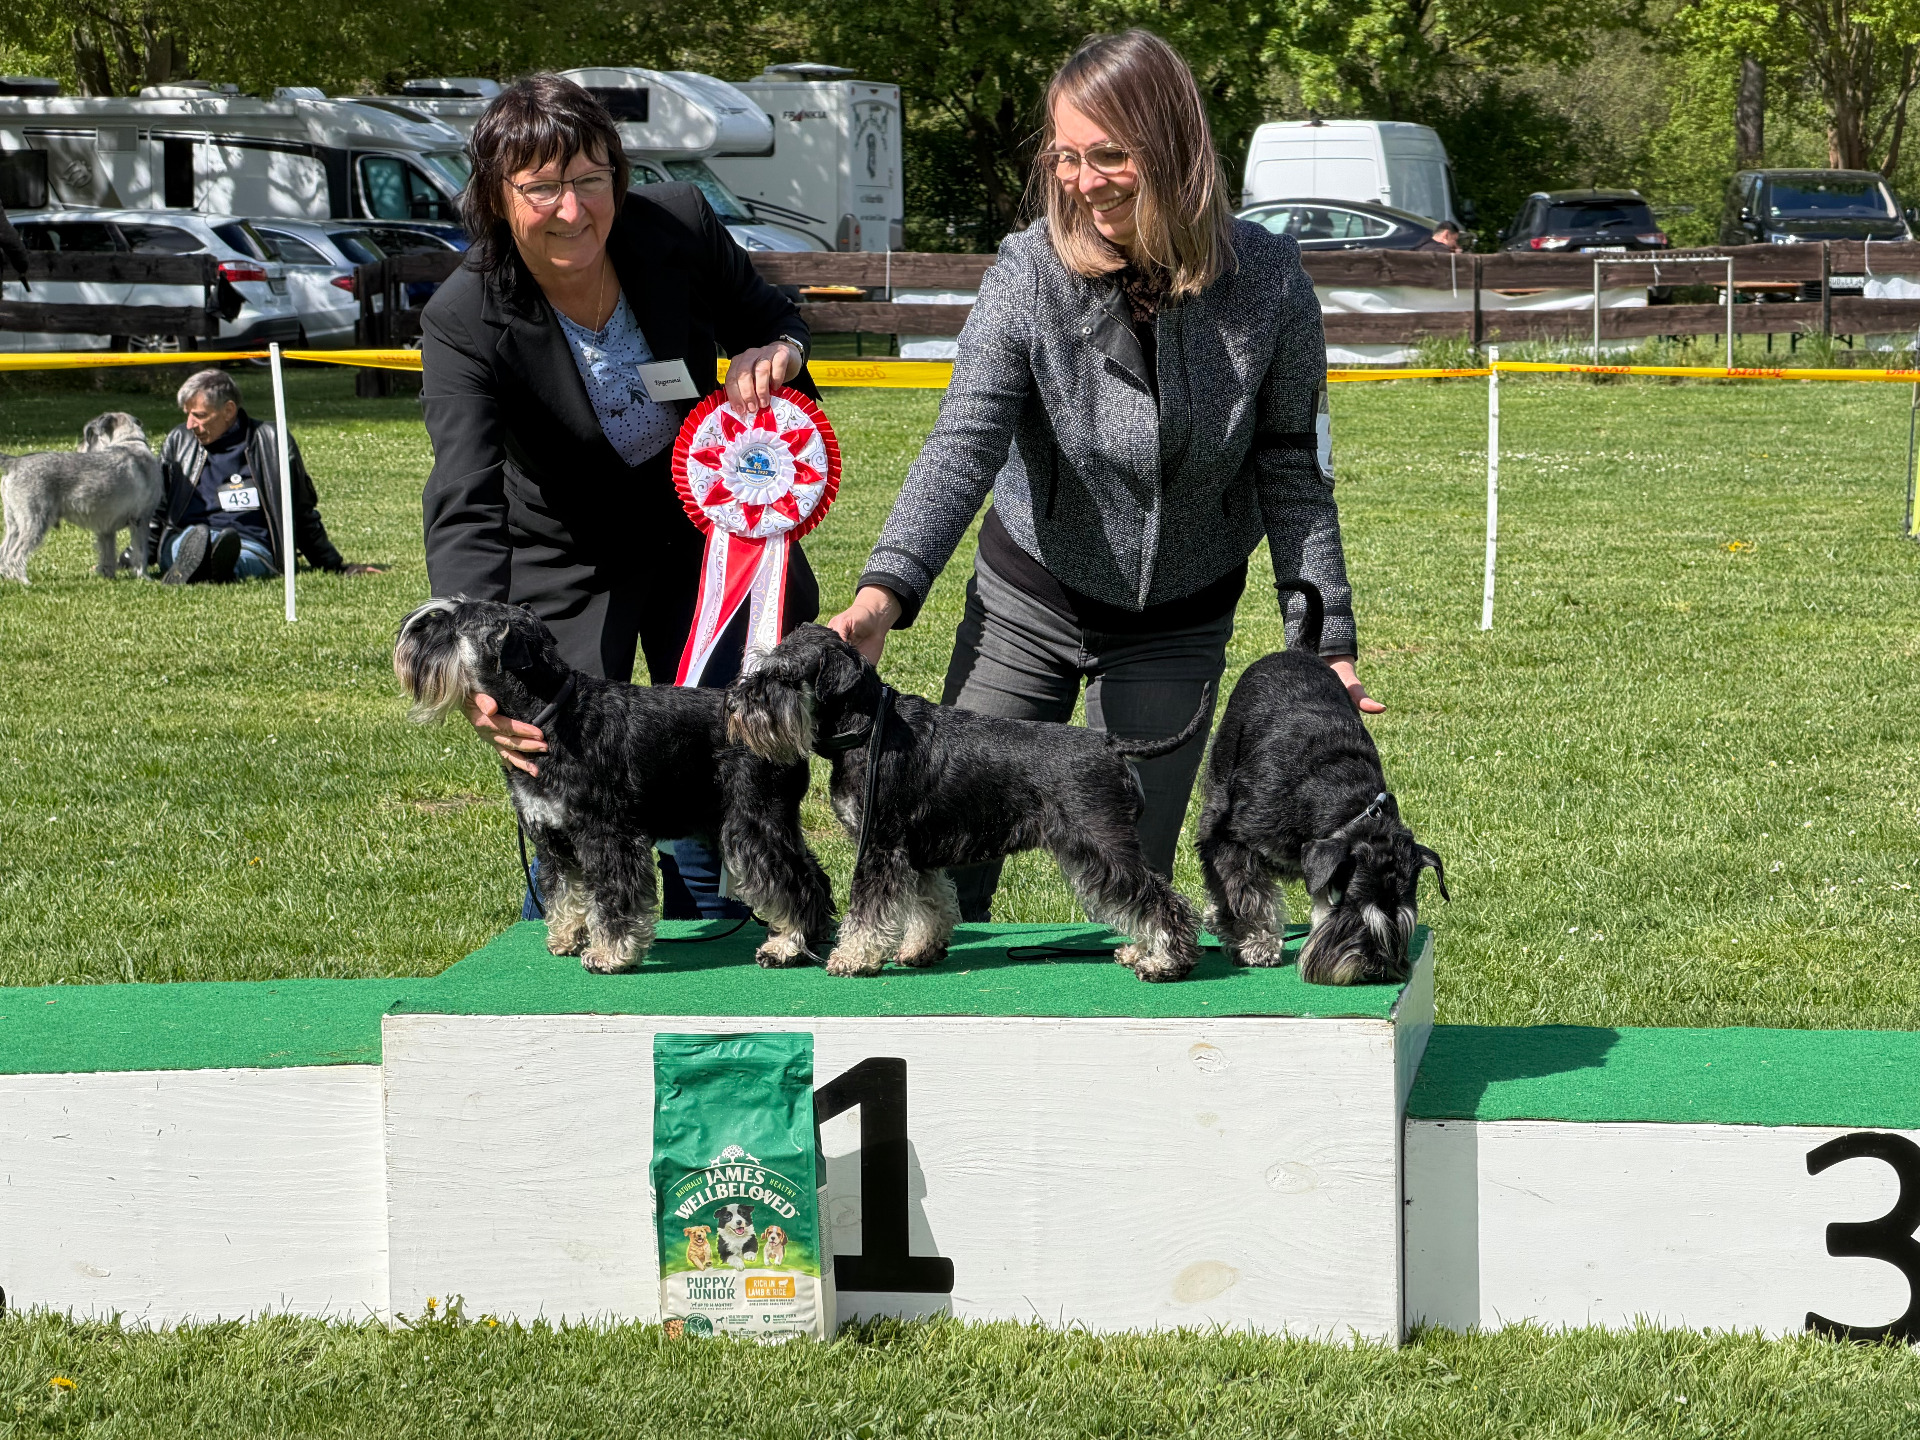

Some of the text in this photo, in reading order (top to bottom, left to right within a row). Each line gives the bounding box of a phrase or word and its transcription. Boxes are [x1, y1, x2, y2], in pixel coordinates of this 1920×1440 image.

[783, 110, 827, 121] FRANKIA
[229, 491, 250, 506] 43
[705, 1167, 766, 1185] JAMES
[814, 1056, 955, 1293] 1
[675, 1177, 703, 1198] NATURALLY
[769, 1179, 797, 1198] HEALTHY
[674, 1183, 797, 1220] WELLBELOVED
[1805, 1131, 1920, 1347] 3
[686, 1276, 735, 1288] PUPPY/
[753, 1279, 776, 1288] RICH IN
[686, 1287, 736, 1300] JUNIOR
[747, 1288, 787, 1297] LAMB & RICE
